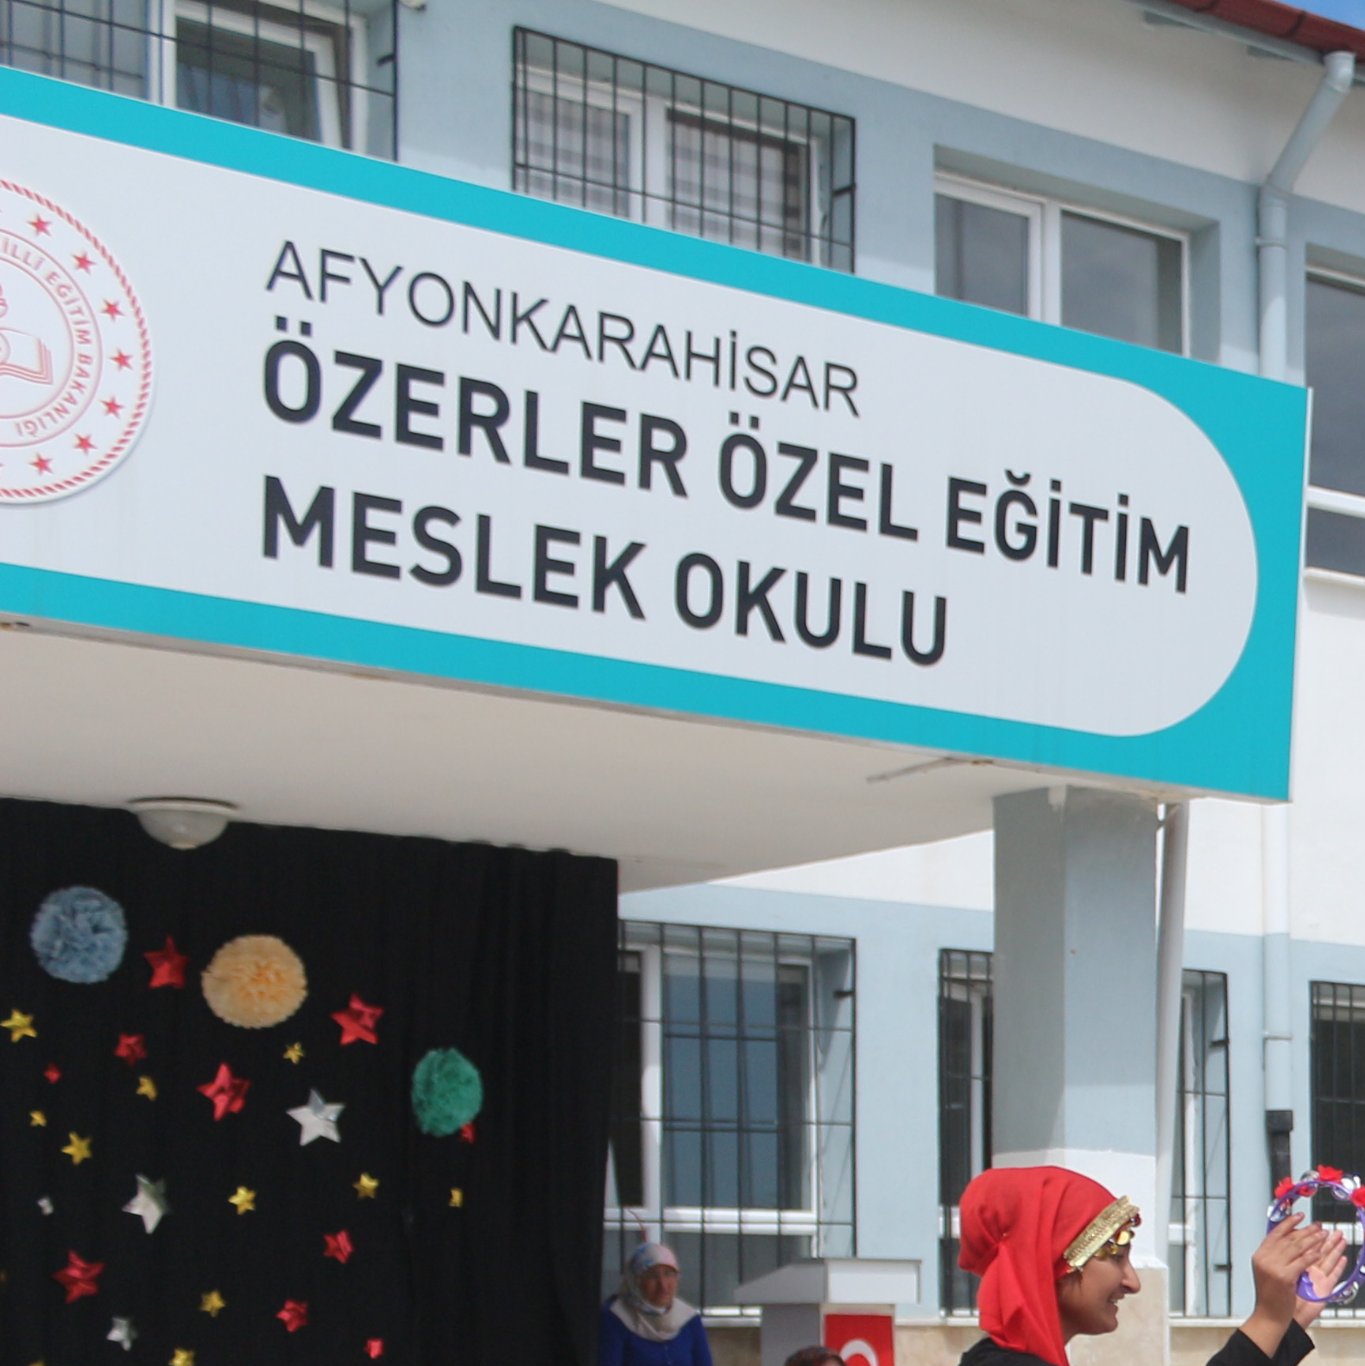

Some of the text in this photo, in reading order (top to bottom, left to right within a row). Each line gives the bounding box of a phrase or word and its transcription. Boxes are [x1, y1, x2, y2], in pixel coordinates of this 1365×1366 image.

[0, 237, 46, 271] İLLİ
[45, 270, 93, 345] EĞİTİM
[264, 239, 860, 418] AFYONKARAHİSAR
[262, 314, 1190, 594] ÖZERLER ÖZEL EĞİTİM
[262, 474, 949, 667] MESLEK OKULU
